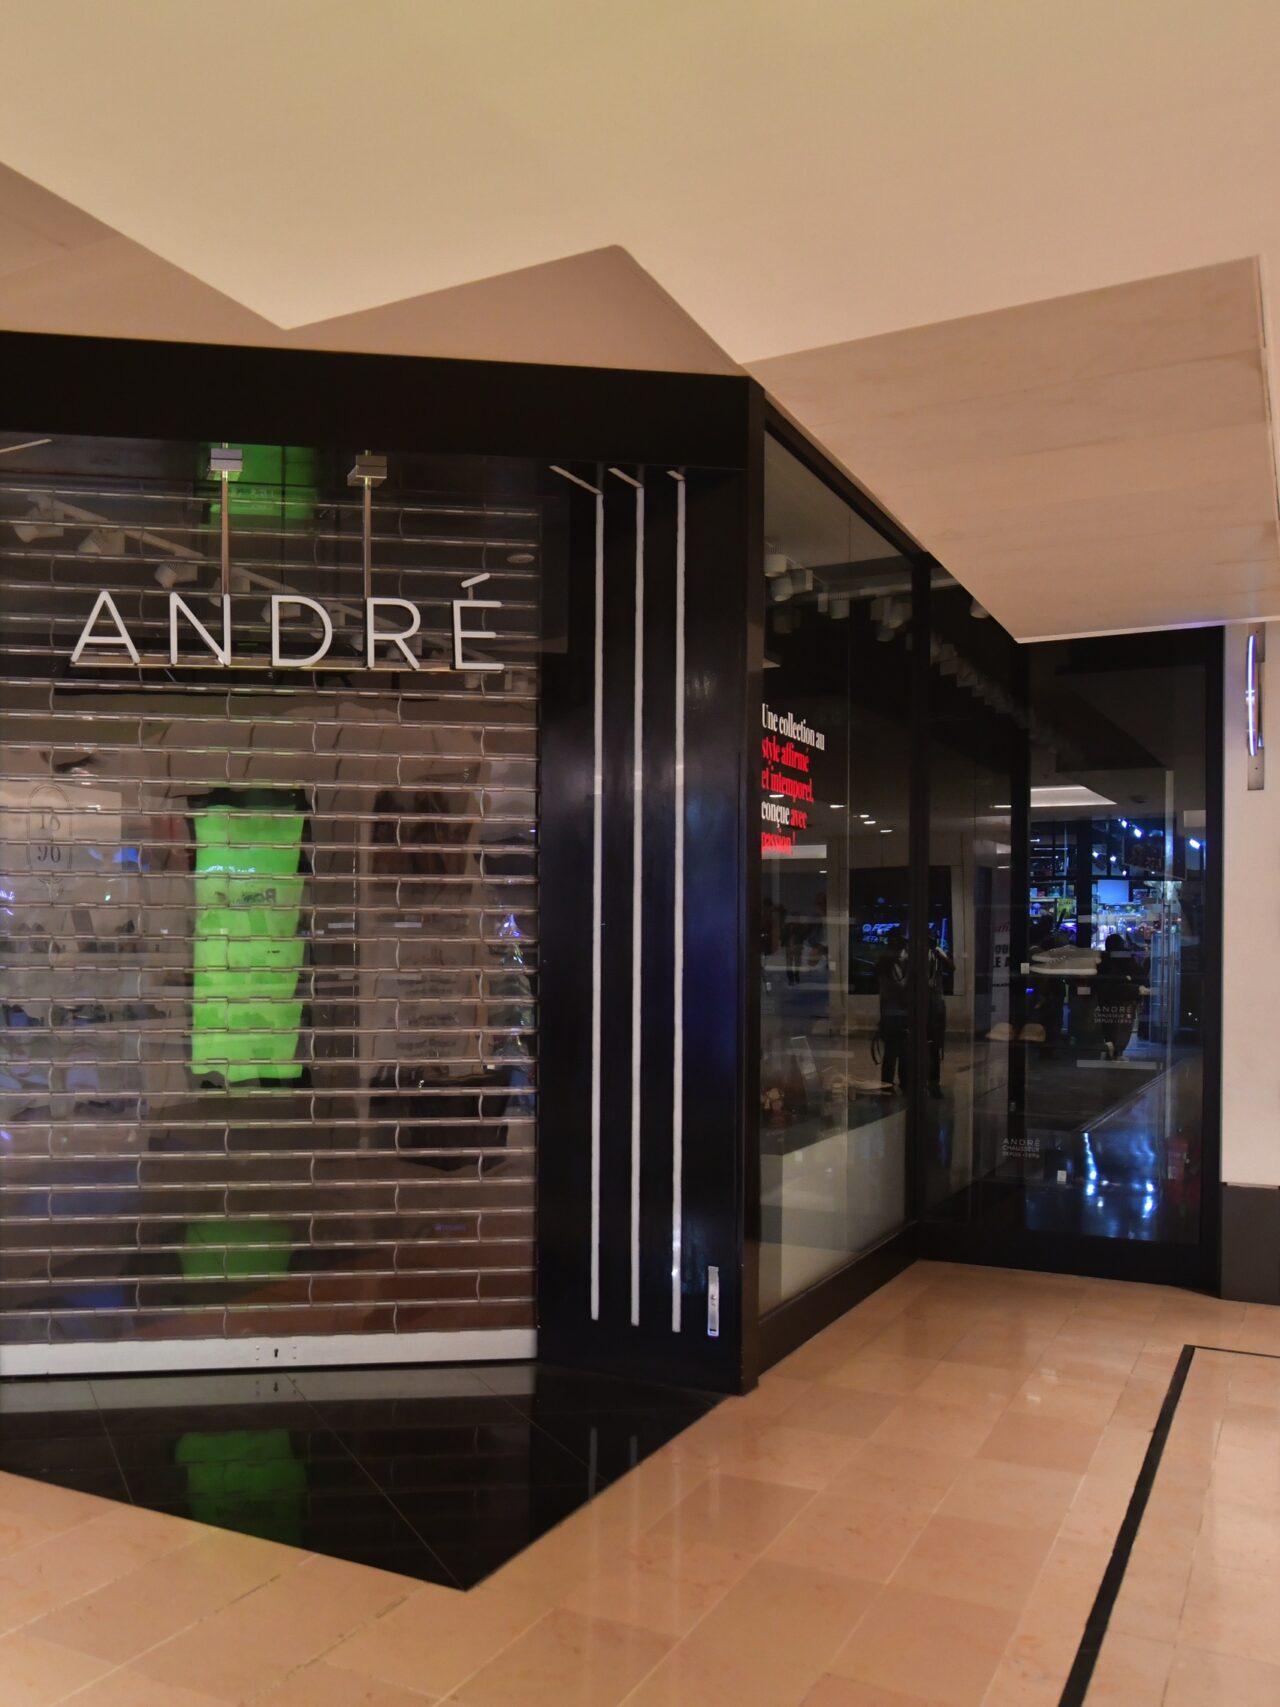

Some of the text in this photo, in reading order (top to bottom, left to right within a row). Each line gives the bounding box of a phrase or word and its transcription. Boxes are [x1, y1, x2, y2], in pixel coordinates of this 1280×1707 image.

[71, 572, 505, 671] ANDRÉ
[762, 703, 778, 732] Une
[779, 712, 815, 747] collection
[761, 801, 790, 829] conçue
